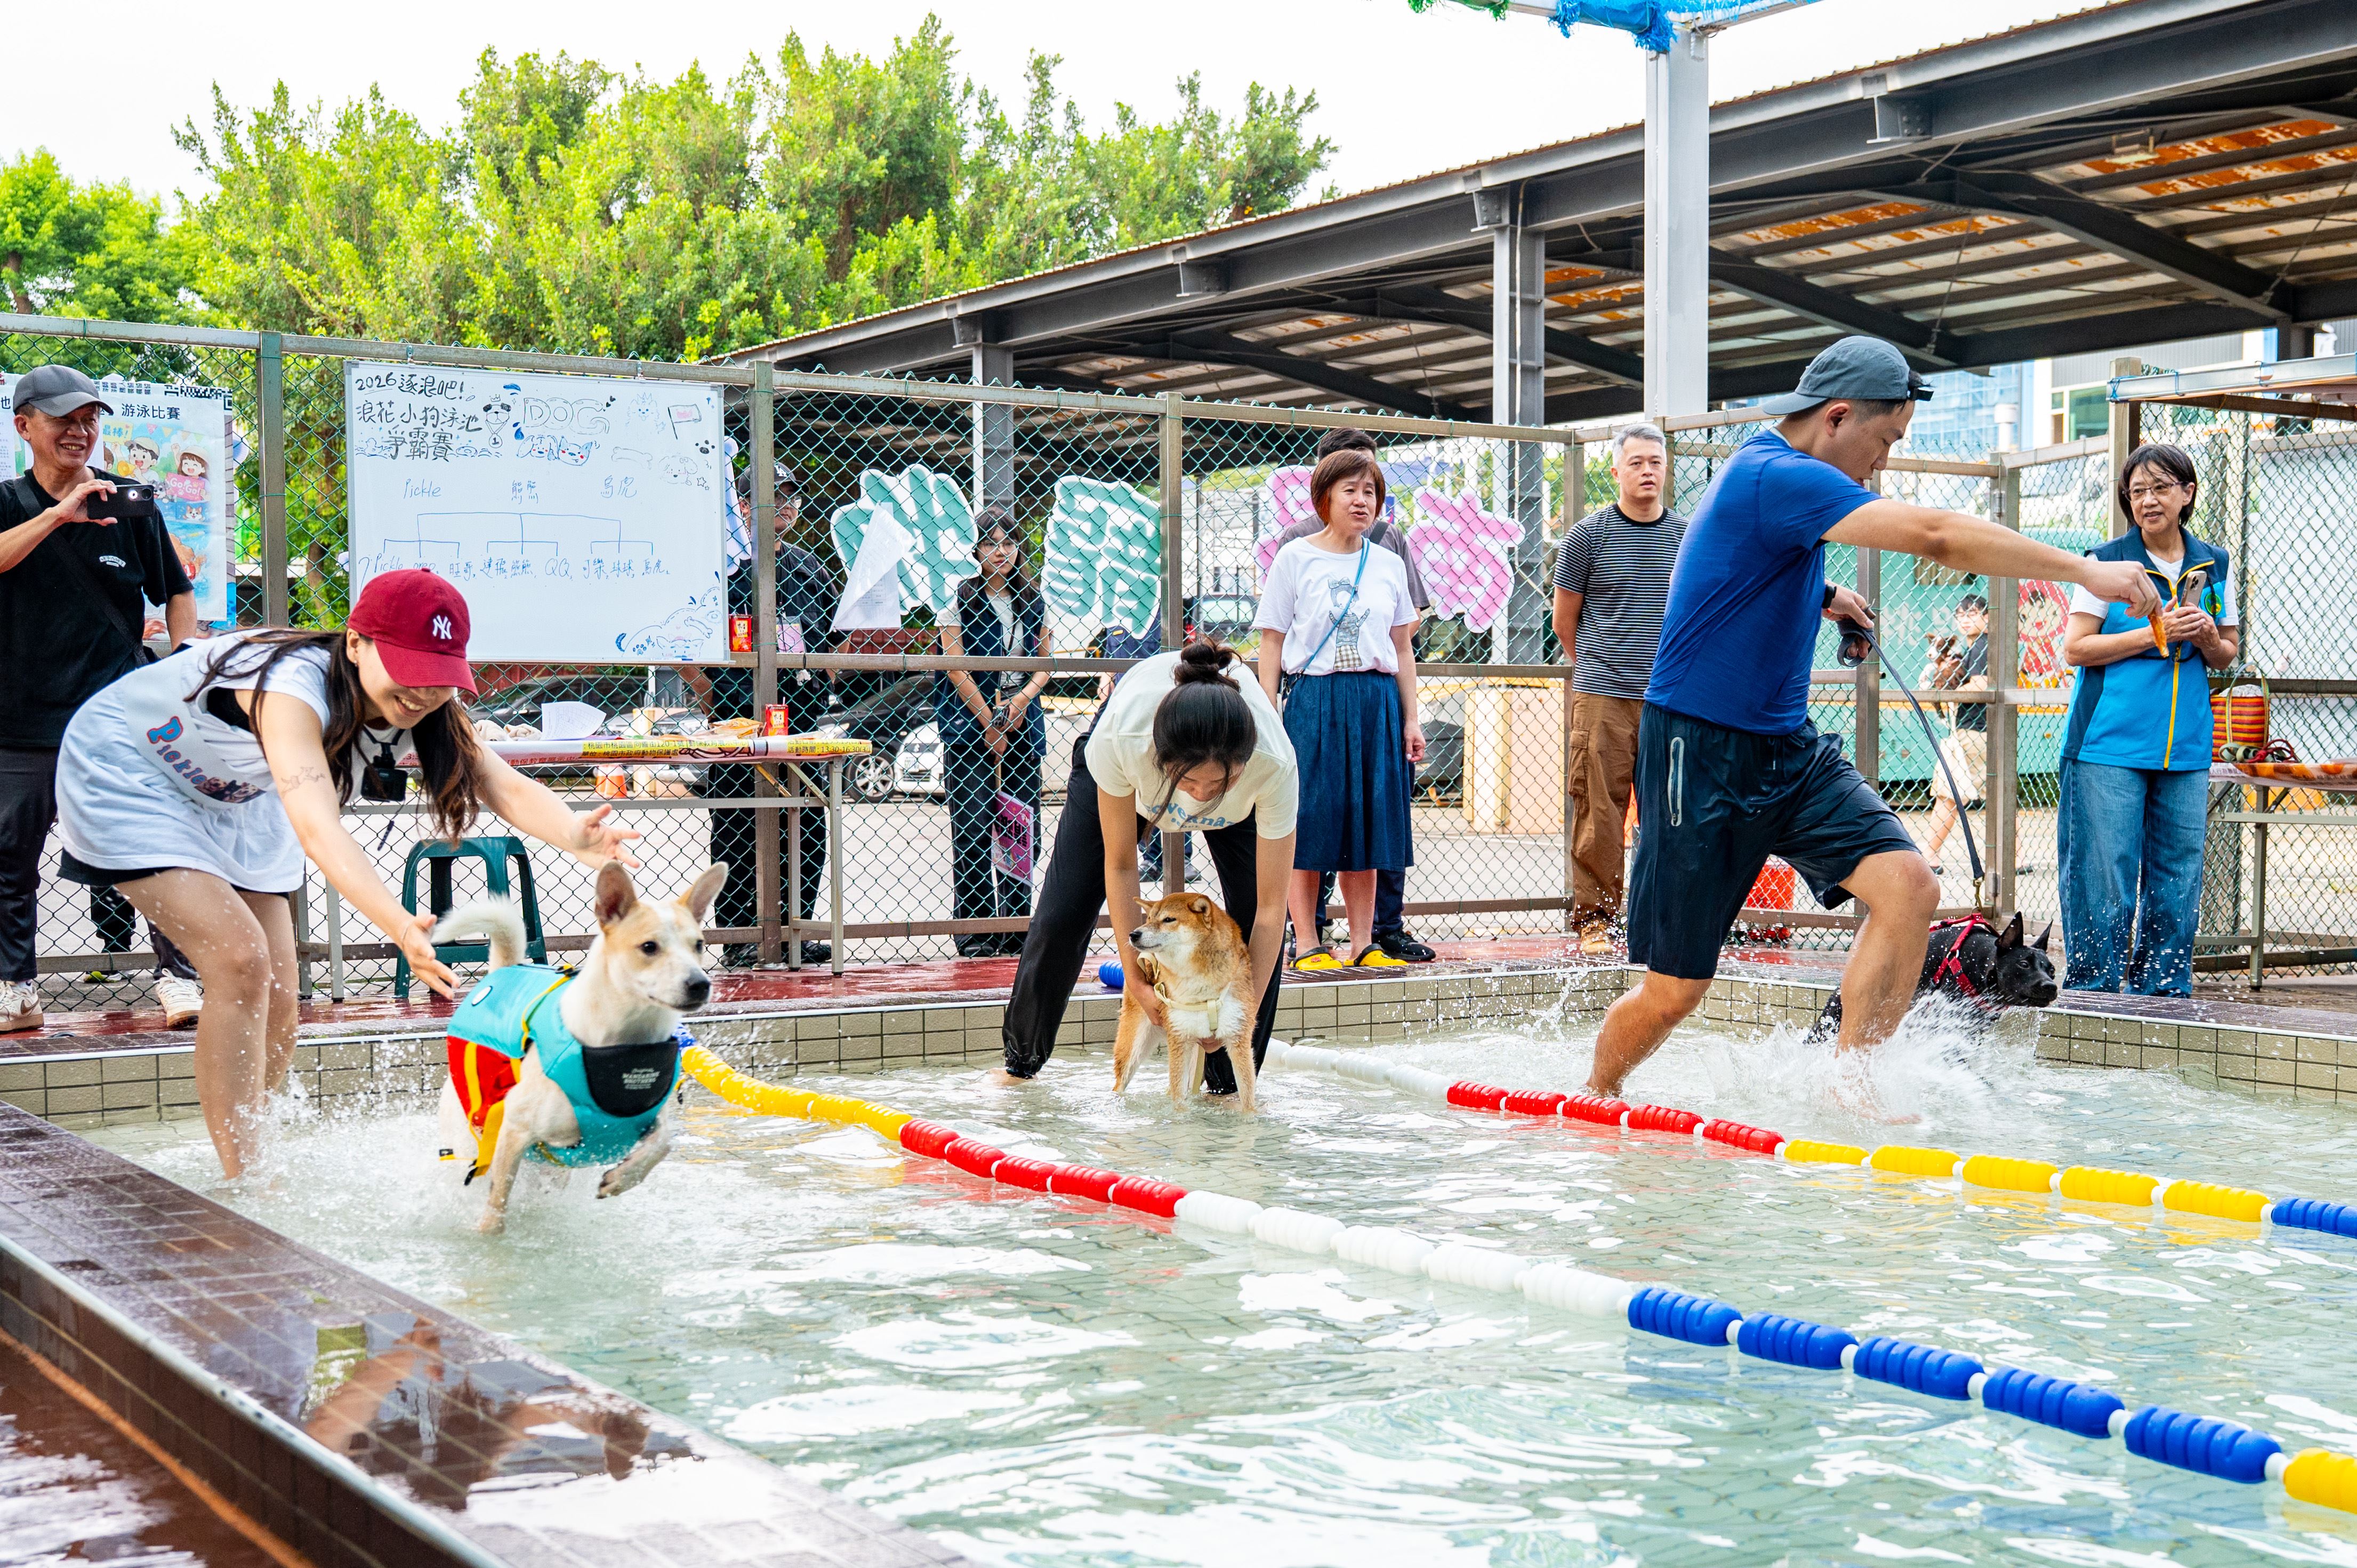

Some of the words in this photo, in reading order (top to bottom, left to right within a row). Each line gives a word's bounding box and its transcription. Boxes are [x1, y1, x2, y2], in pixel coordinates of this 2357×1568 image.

[122, 403, 180, 420] 游泳比賽
[356, 400, 482, 432] 浪花小狗泳池
[524, 397, 610, 435] DOG
[384, 424, 453, 462] 爭霸賽
[186, 485, 201, 496] Go!
[404, 478, 441, 499] Pickle
[432, 614, 452, 640] NY
[147, 715, 207, 785] Pickle
